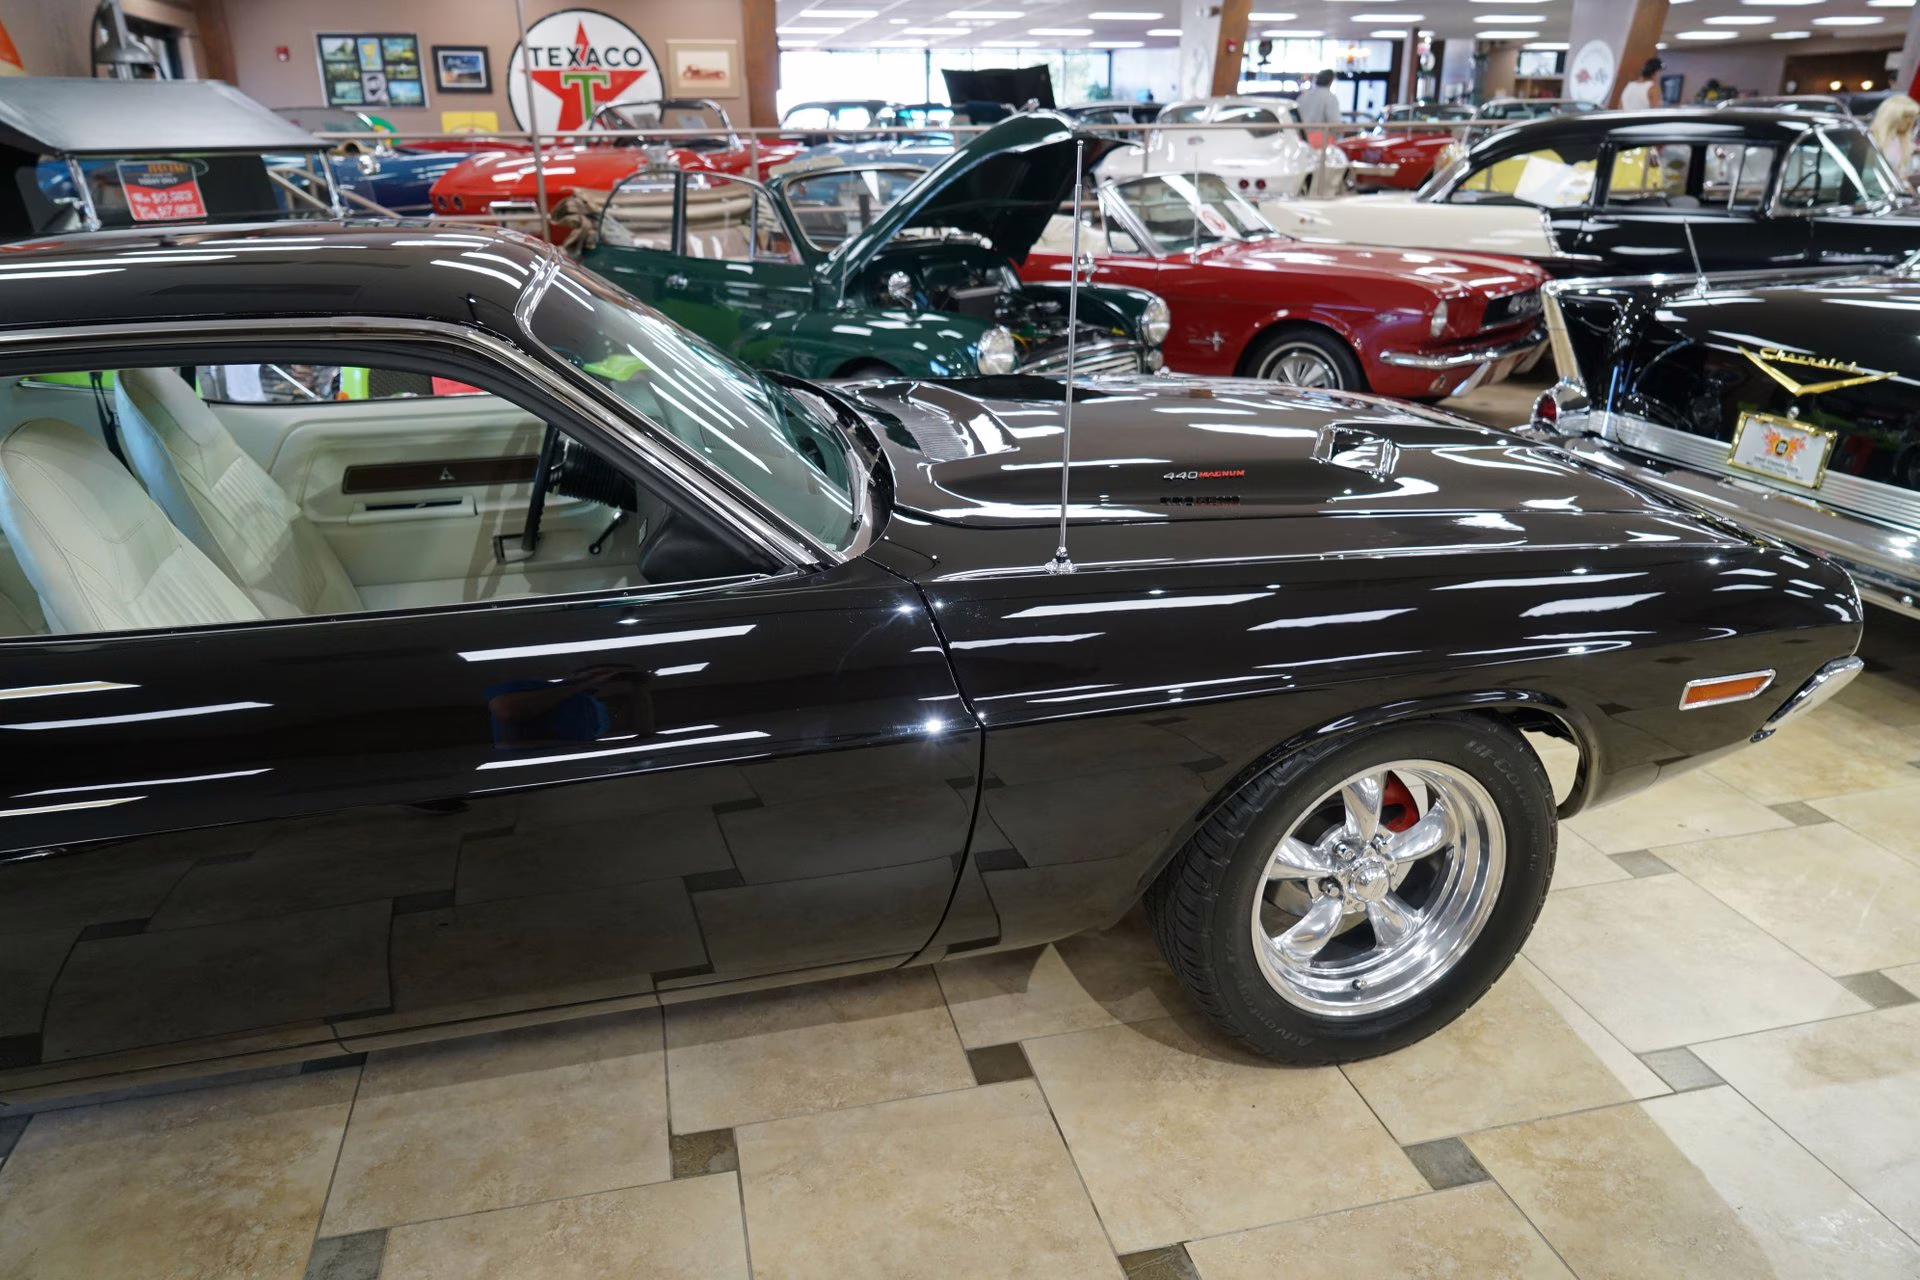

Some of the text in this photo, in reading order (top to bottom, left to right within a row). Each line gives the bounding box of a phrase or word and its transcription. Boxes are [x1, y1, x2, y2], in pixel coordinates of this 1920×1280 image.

[527, 47, 642, 67] TEXACO
[1760, 347, 1864, 375] Chevrolet
[1163, 469, 1246, 480] 440 MAGNUM
